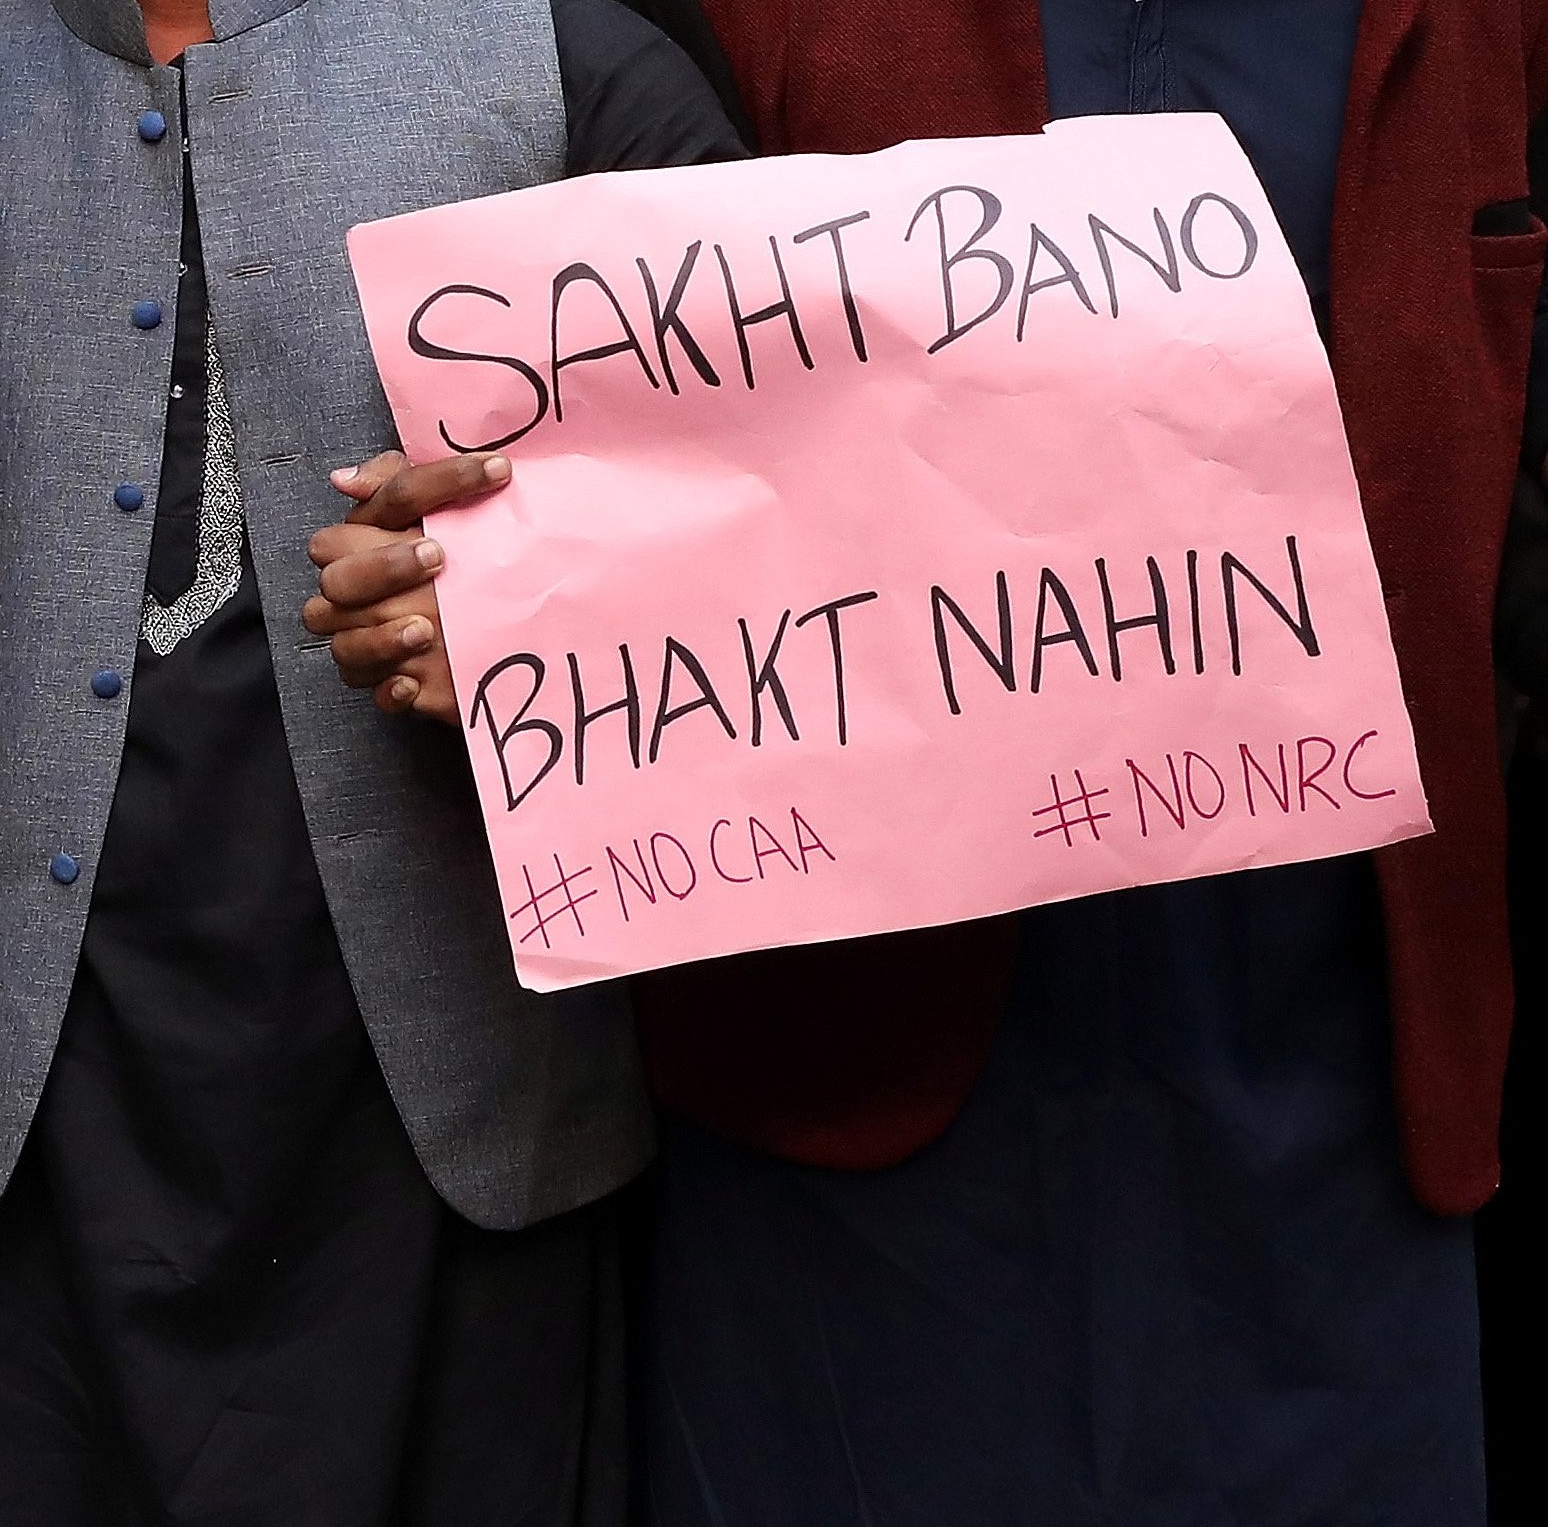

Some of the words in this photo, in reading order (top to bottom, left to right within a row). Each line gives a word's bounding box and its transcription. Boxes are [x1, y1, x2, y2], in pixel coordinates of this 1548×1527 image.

[407, 212, 873, 454] SAKHT
[904, 185, 1258, 355] BANO
[470, 591, 876, 813] BHAKT
[930, 535, 1319, 714] NAHIN
